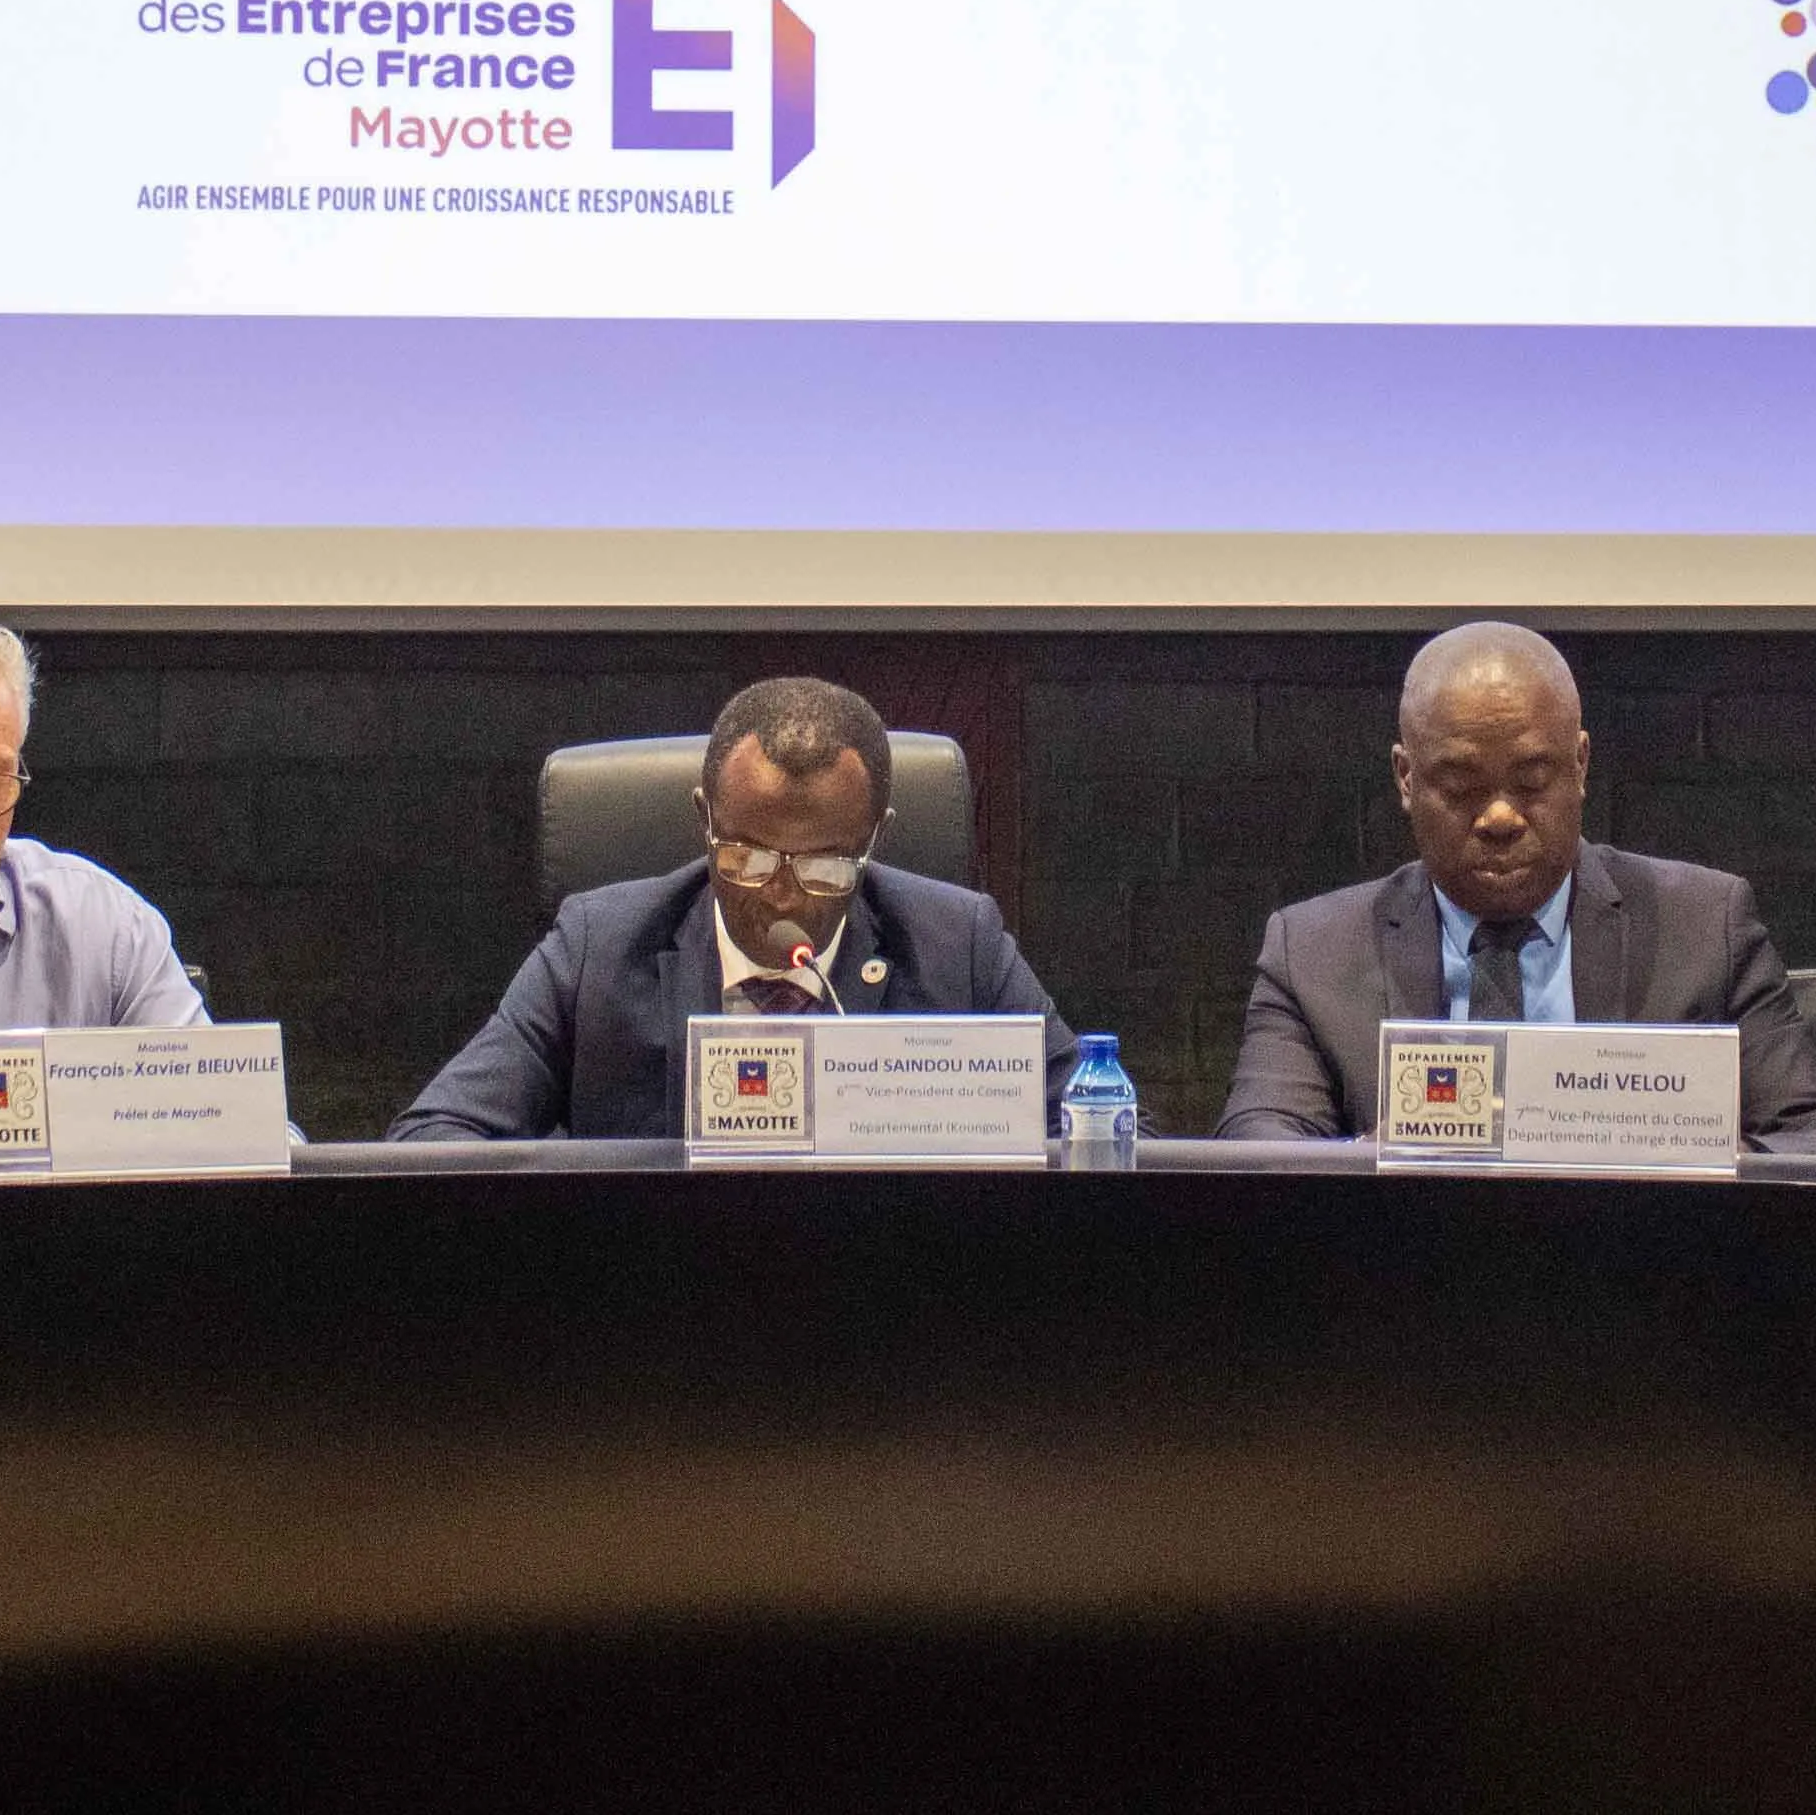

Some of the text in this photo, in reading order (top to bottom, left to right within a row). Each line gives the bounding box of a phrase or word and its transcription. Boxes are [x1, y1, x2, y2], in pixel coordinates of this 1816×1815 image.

[304, 48, 575, 89] de France
[351, 107, 572, 157] Mayotte
[137, 185, 733, 214] AGIR ENSEMBLE POUR UNE CROISSANCE RESPONSABLE
[49, 1057, 279, 1081] François-Xavier BIEUVILLE
[824, 1059, 1033, 1073] Daoud SAINDOU MALIDE
[1555, 1072, 1685, 1092] Madi VELOU
[718, 1116, 798, 1130] MAYOTTE
[1406, 1123, 1486, 1137] MAYOTTE
